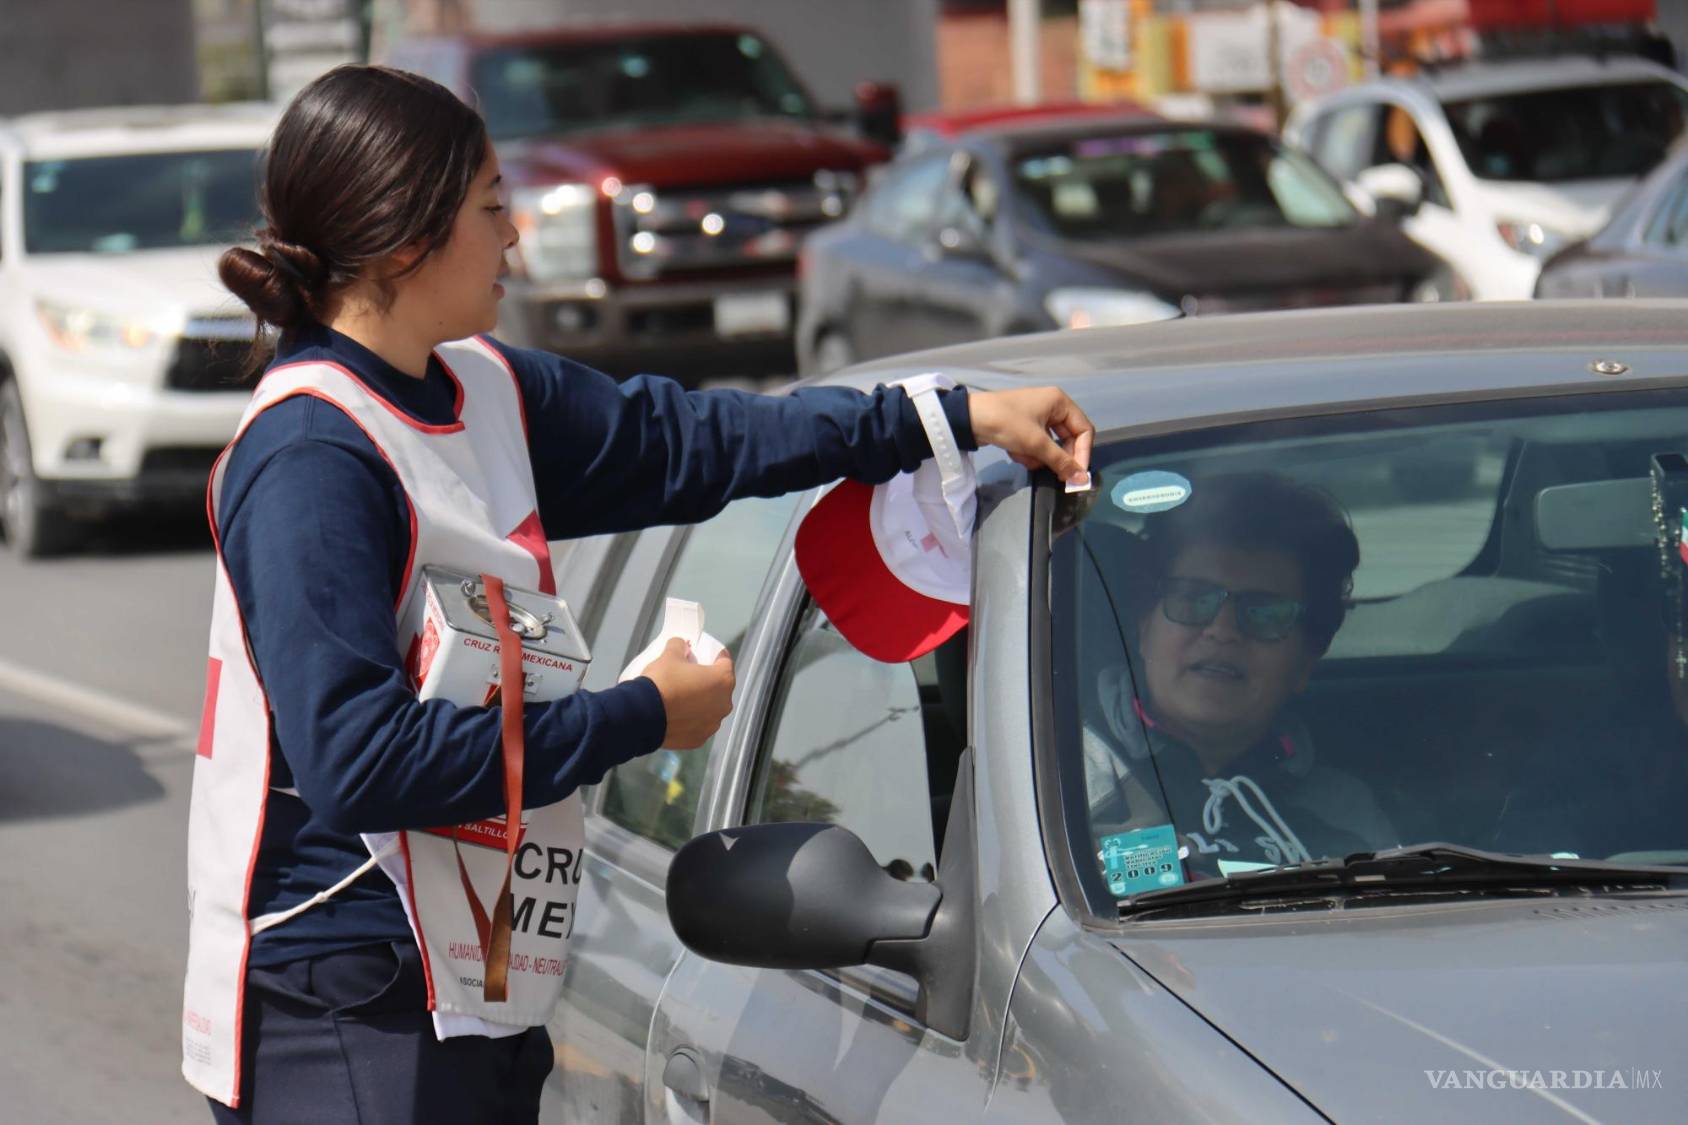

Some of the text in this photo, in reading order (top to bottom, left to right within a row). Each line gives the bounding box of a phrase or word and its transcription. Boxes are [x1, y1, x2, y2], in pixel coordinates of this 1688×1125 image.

[463, 637, 492, 652] CRUZ
[521, 652, 573, 672] MEXICANA
[514, 842, 583, 885] CRU
[1111, 863, 1173, 882] 2009
[448, 941, 482, 962] HUMANID
[458, 975, 483, 988] ASOCIA
